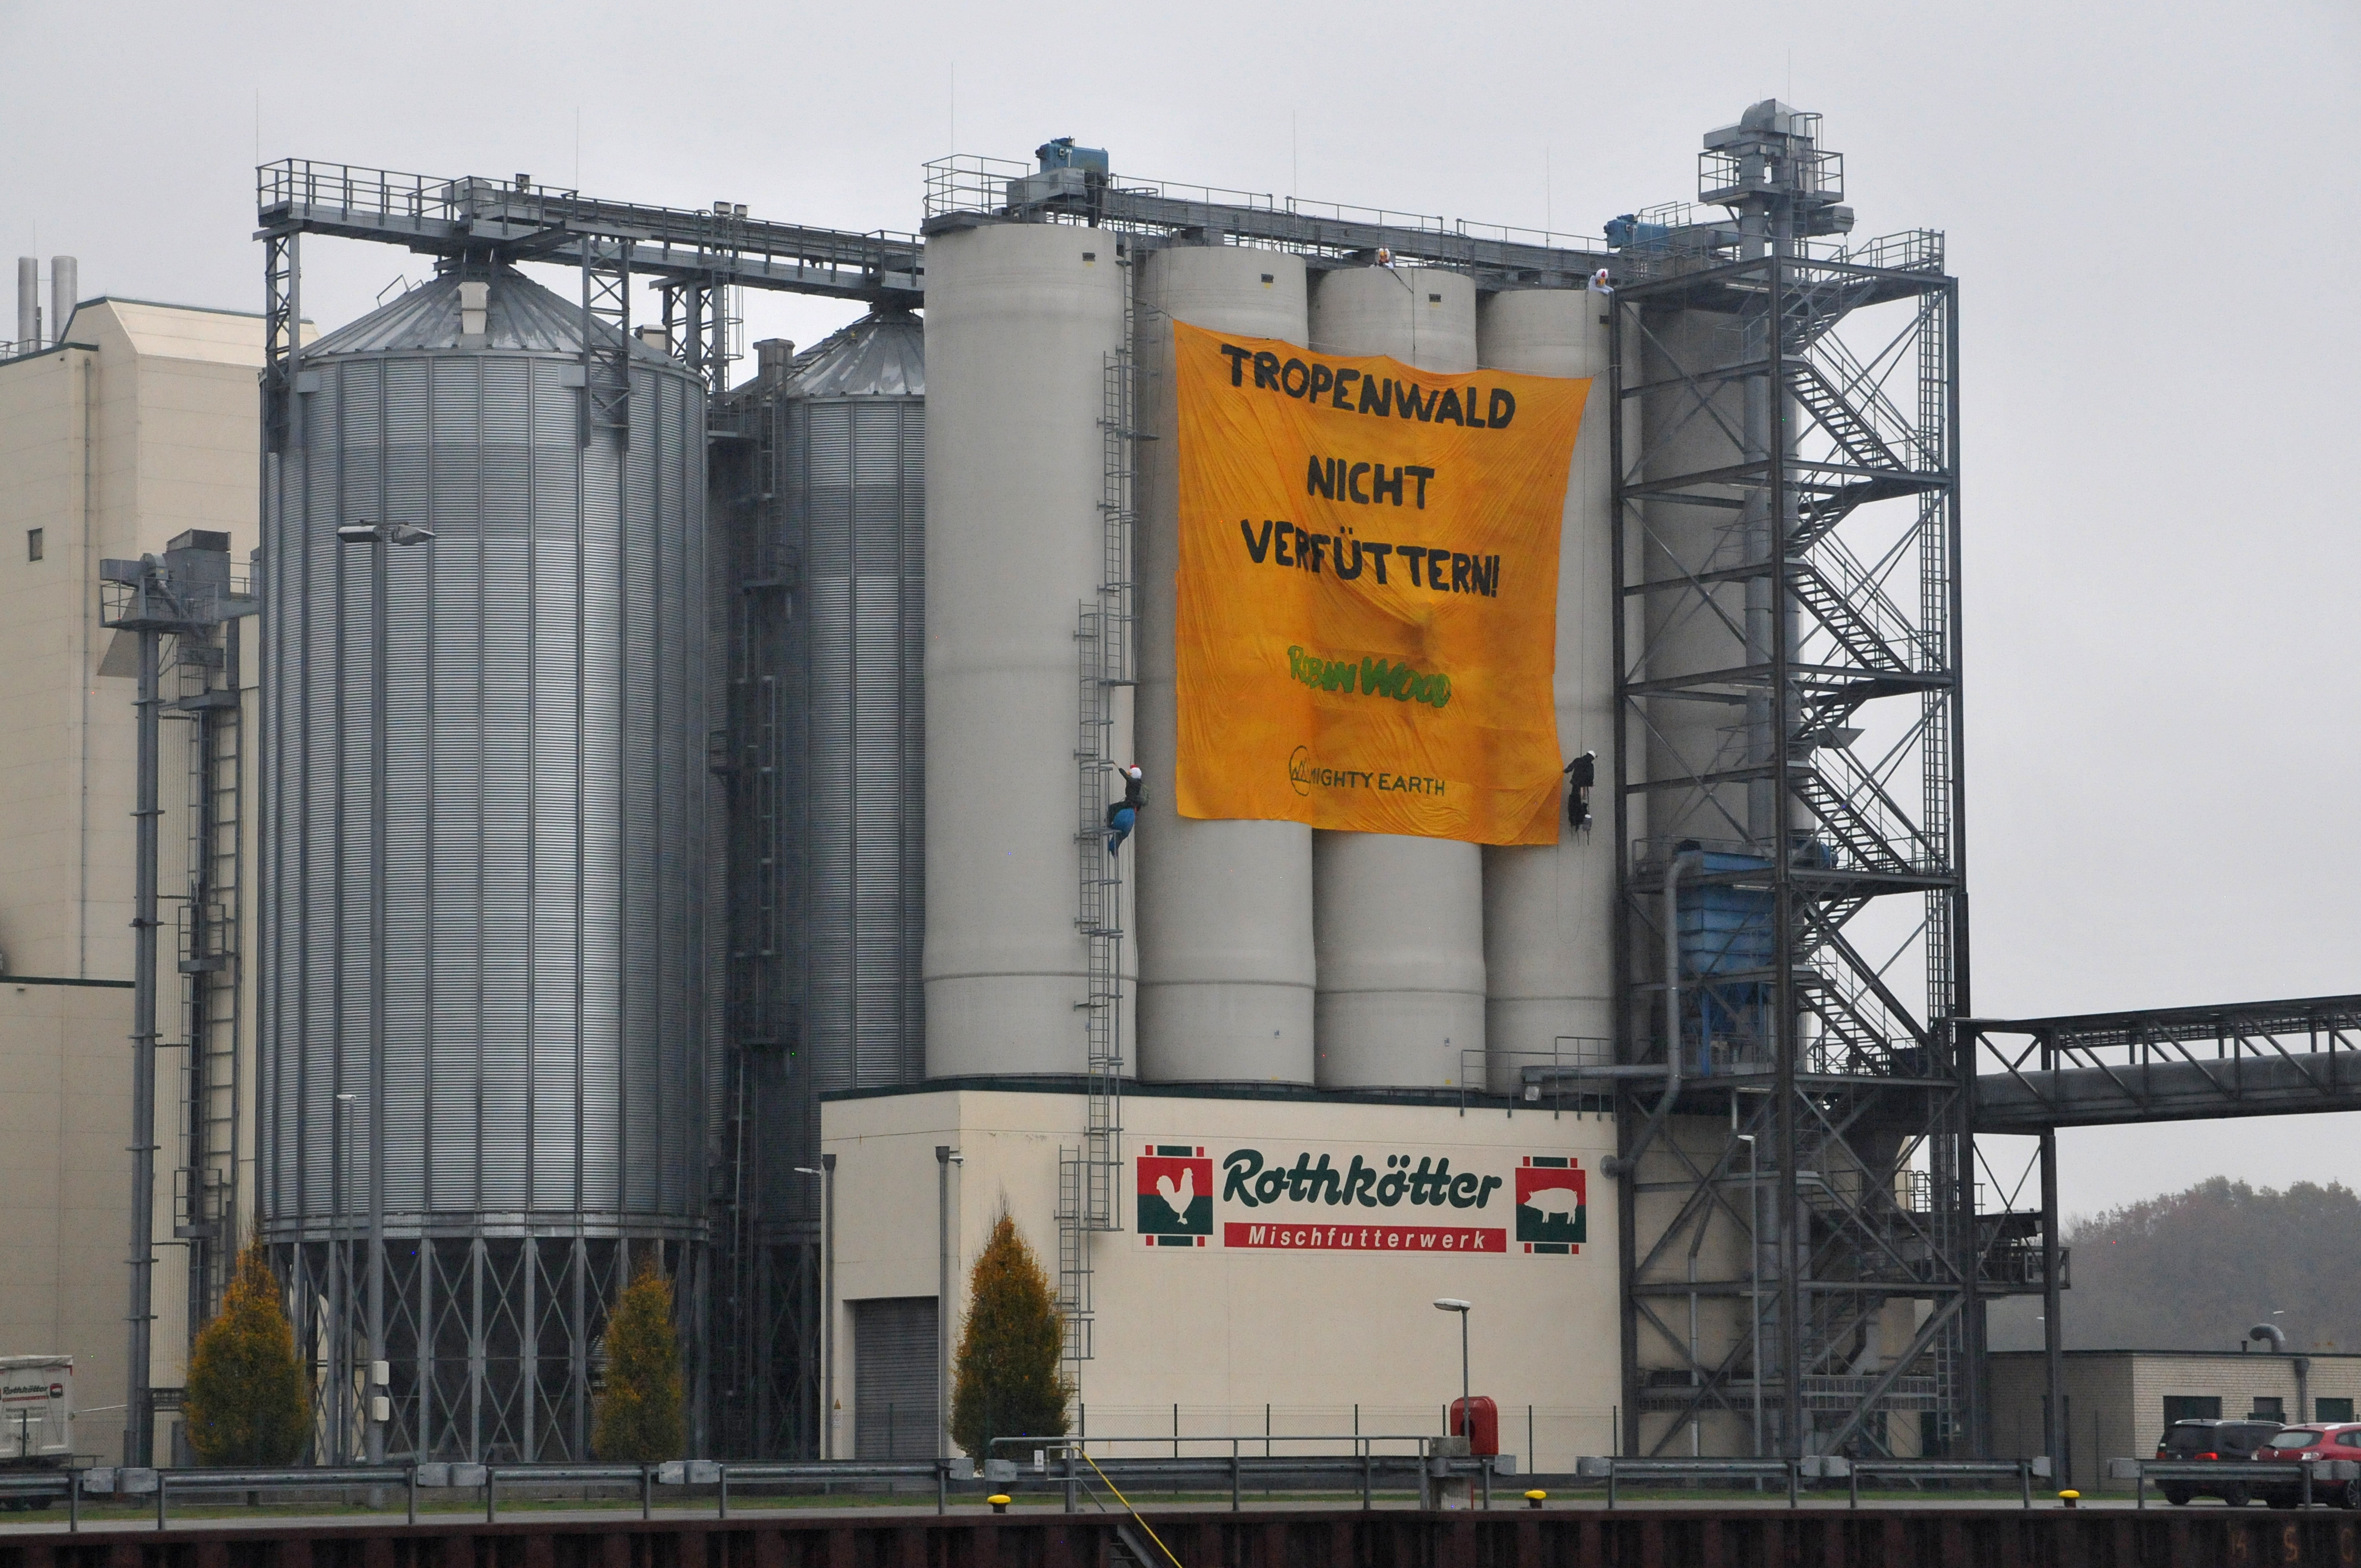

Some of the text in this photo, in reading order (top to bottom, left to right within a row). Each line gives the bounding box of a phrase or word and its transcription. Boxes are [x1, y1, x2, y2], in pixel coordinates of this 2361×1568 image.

[1221, 343, 1516, 429] TROPENWALD
[1307, 454, 1435, 510] NICHT
[1240, 519, 1500, 598] VERFÜTTERN!
[1360, 656, 1451, 708] WOOD
[1378, 773, 1445, 797] EARTH
[1223, 1149, 1503, 1209] Rothkötter
[1248, 1225, 1485, 1249] Mischfutterwerk
